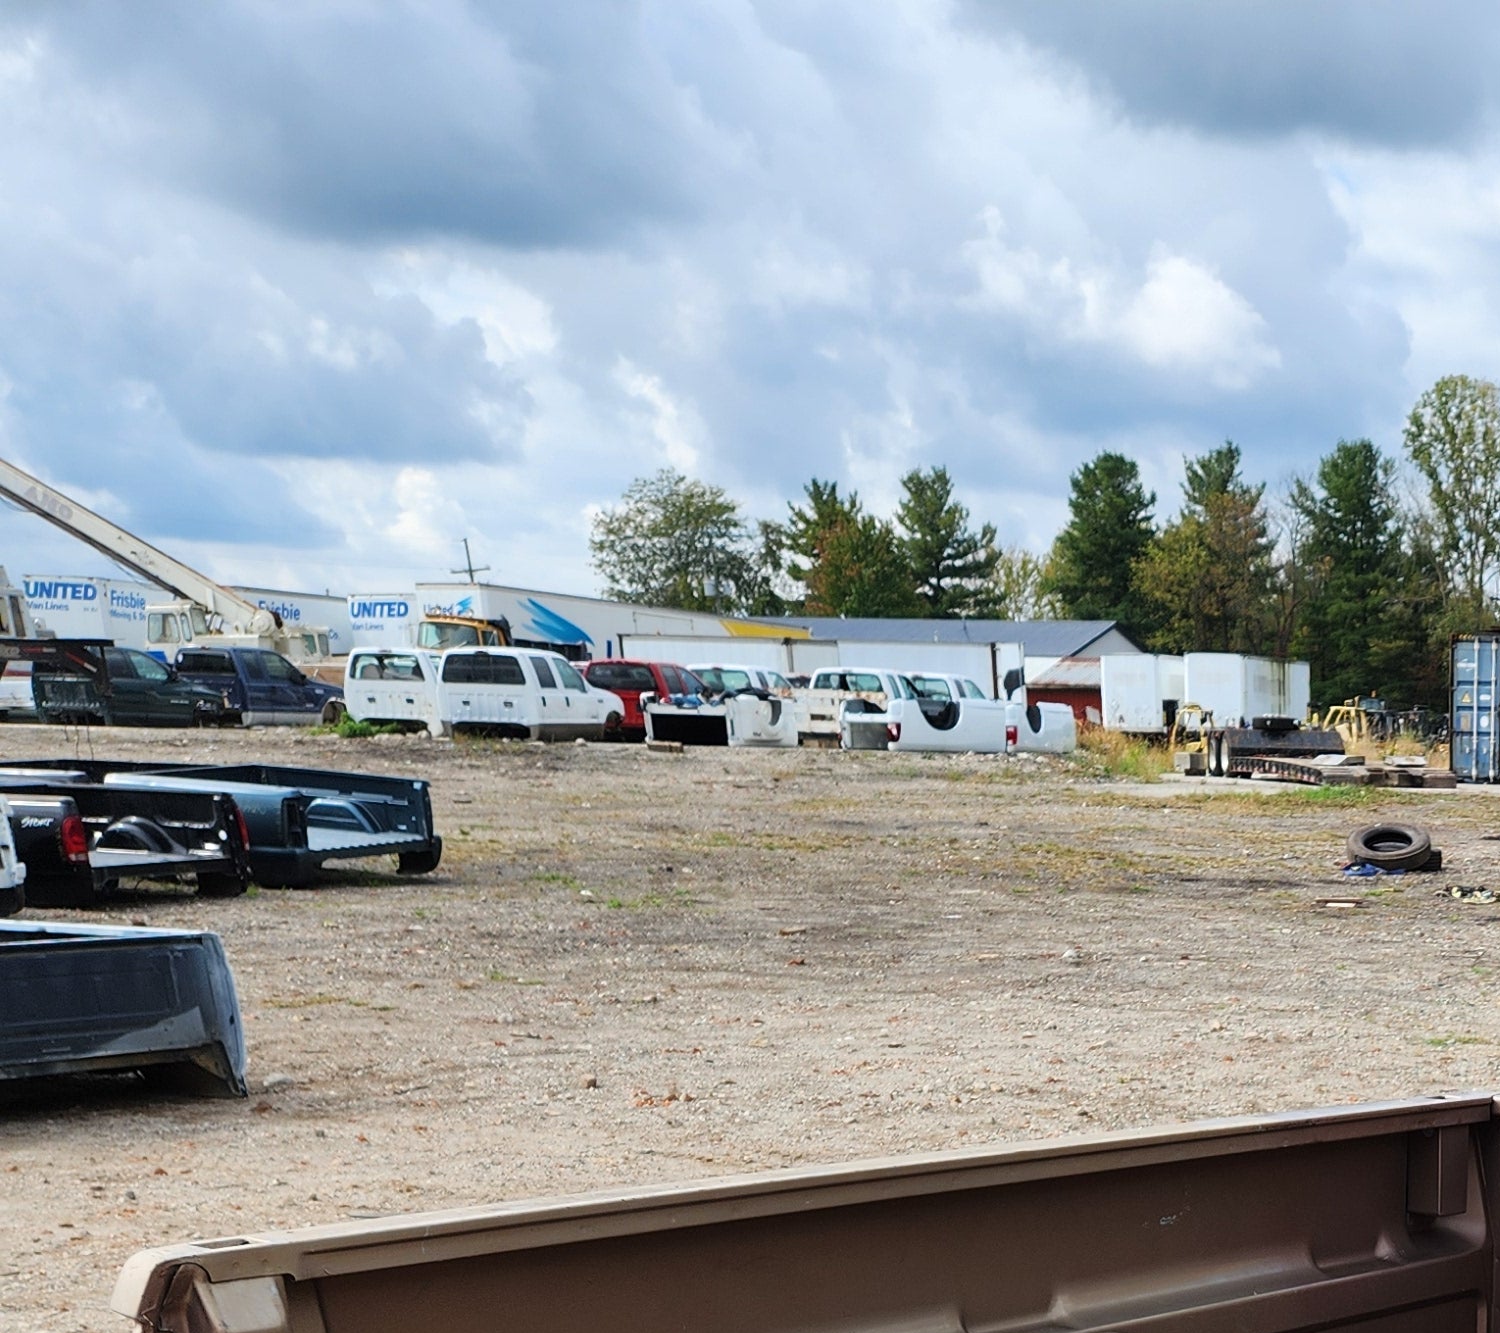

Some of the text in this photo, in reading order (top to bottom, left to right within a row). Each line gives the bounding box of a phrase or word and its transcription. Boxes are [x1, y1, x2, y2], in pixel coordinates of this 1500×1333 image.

[24, 580, 97, 600] UNITED
[110, 589, 146, 610] Frisbie
[45, 603, 69, 611] Lines
[258, 600, 301, 621] Fisbie
[350, 602, 409, 618] UNITED
